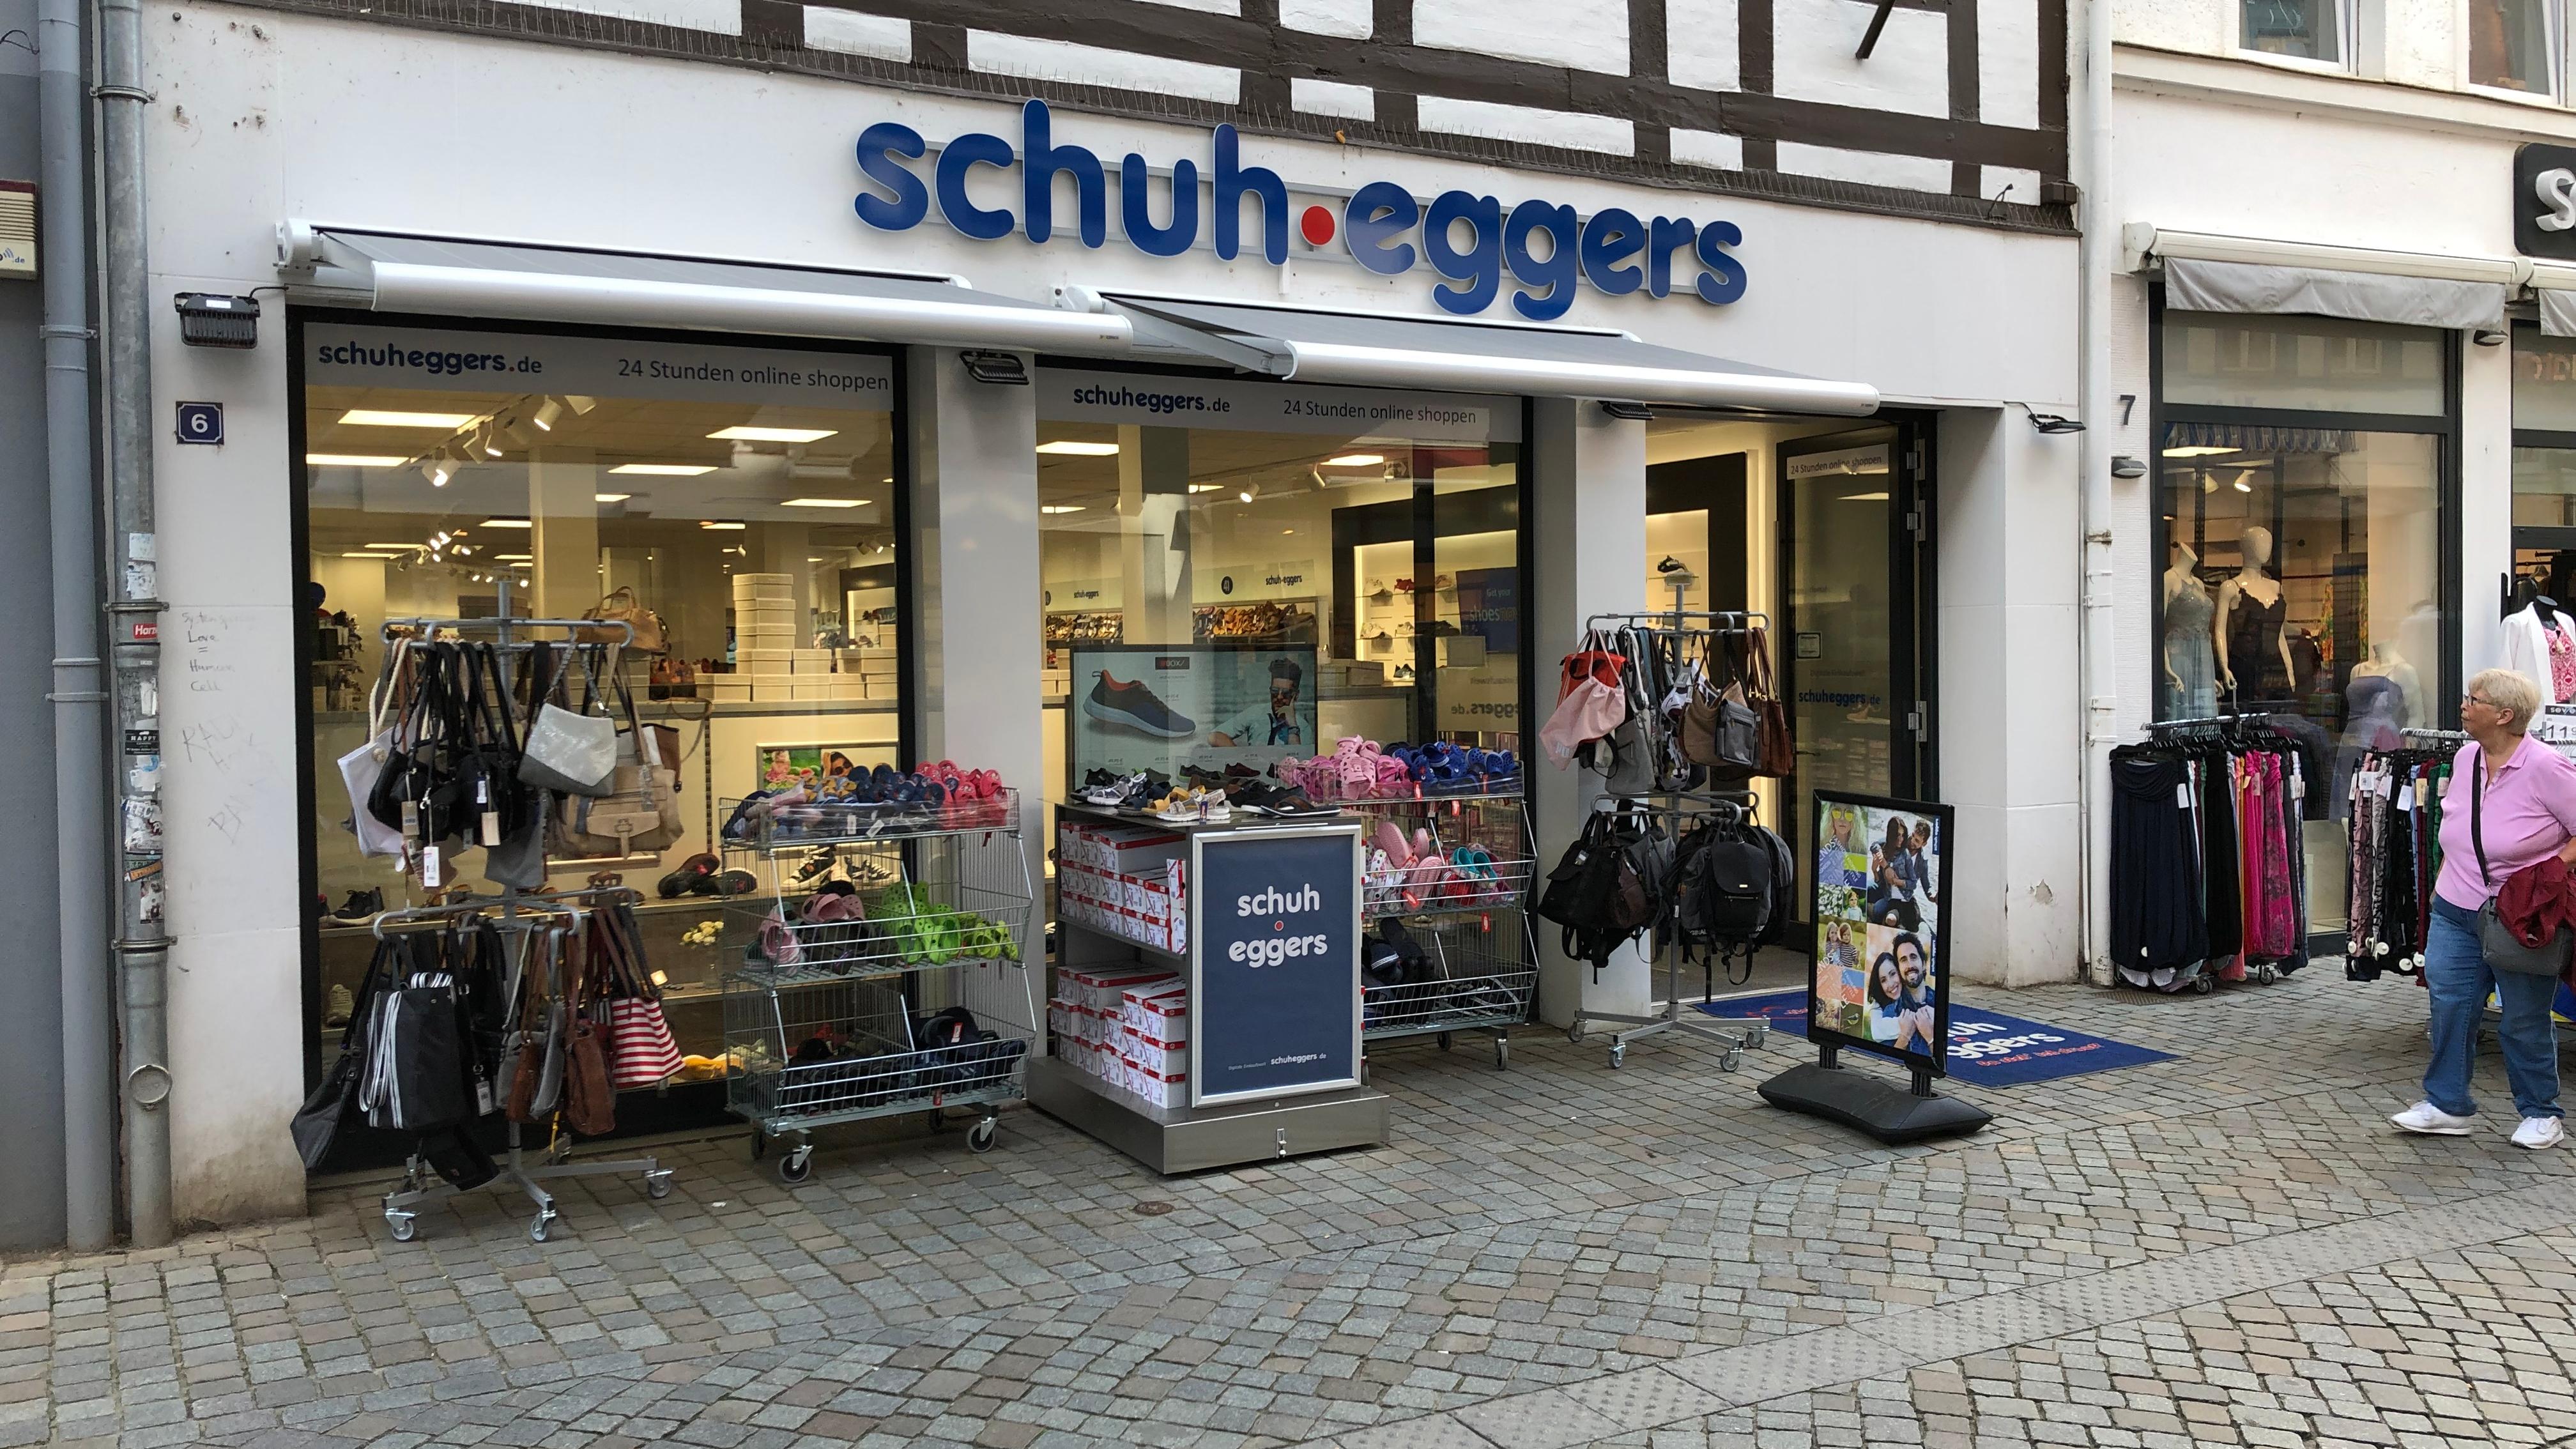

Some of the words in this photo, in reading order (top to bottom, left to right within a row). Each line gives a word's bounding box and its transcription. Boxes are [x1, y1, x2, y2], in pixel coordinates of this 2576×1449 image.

[854, 98, 1289, 266] schuh
[1344, 181, 1747, 321] eggers
[318, 341, 542, 375] schuheggers.de
[618, 358, 643, 377] 24
[650, 360, 734, 383] Stunden
[741, 366, 802, 385] online
[807, 369, 889, 392] shoppen
[1073, 384, 1230, 413] schuheggers.de
[1283, 399, 1302, 415] 24
[1305, 400, 1367, 419] Stunden
[1370, 403, 1414, 421] online
[1417, 406, 1476, 425] shoppen
[2120, 395, 2136, 425] 7
[192, 413, 208, 433] 6
[1791, 465, 1799, 475] 24
[1800, 462, 1828, 473] Stunden
[1829, 459, 1850, 470] online
[1851, 456, 1882, 468] shoppen
[1238, 883, 1320, 917] schuh
[1229, 934, 1328, 968] eggers
